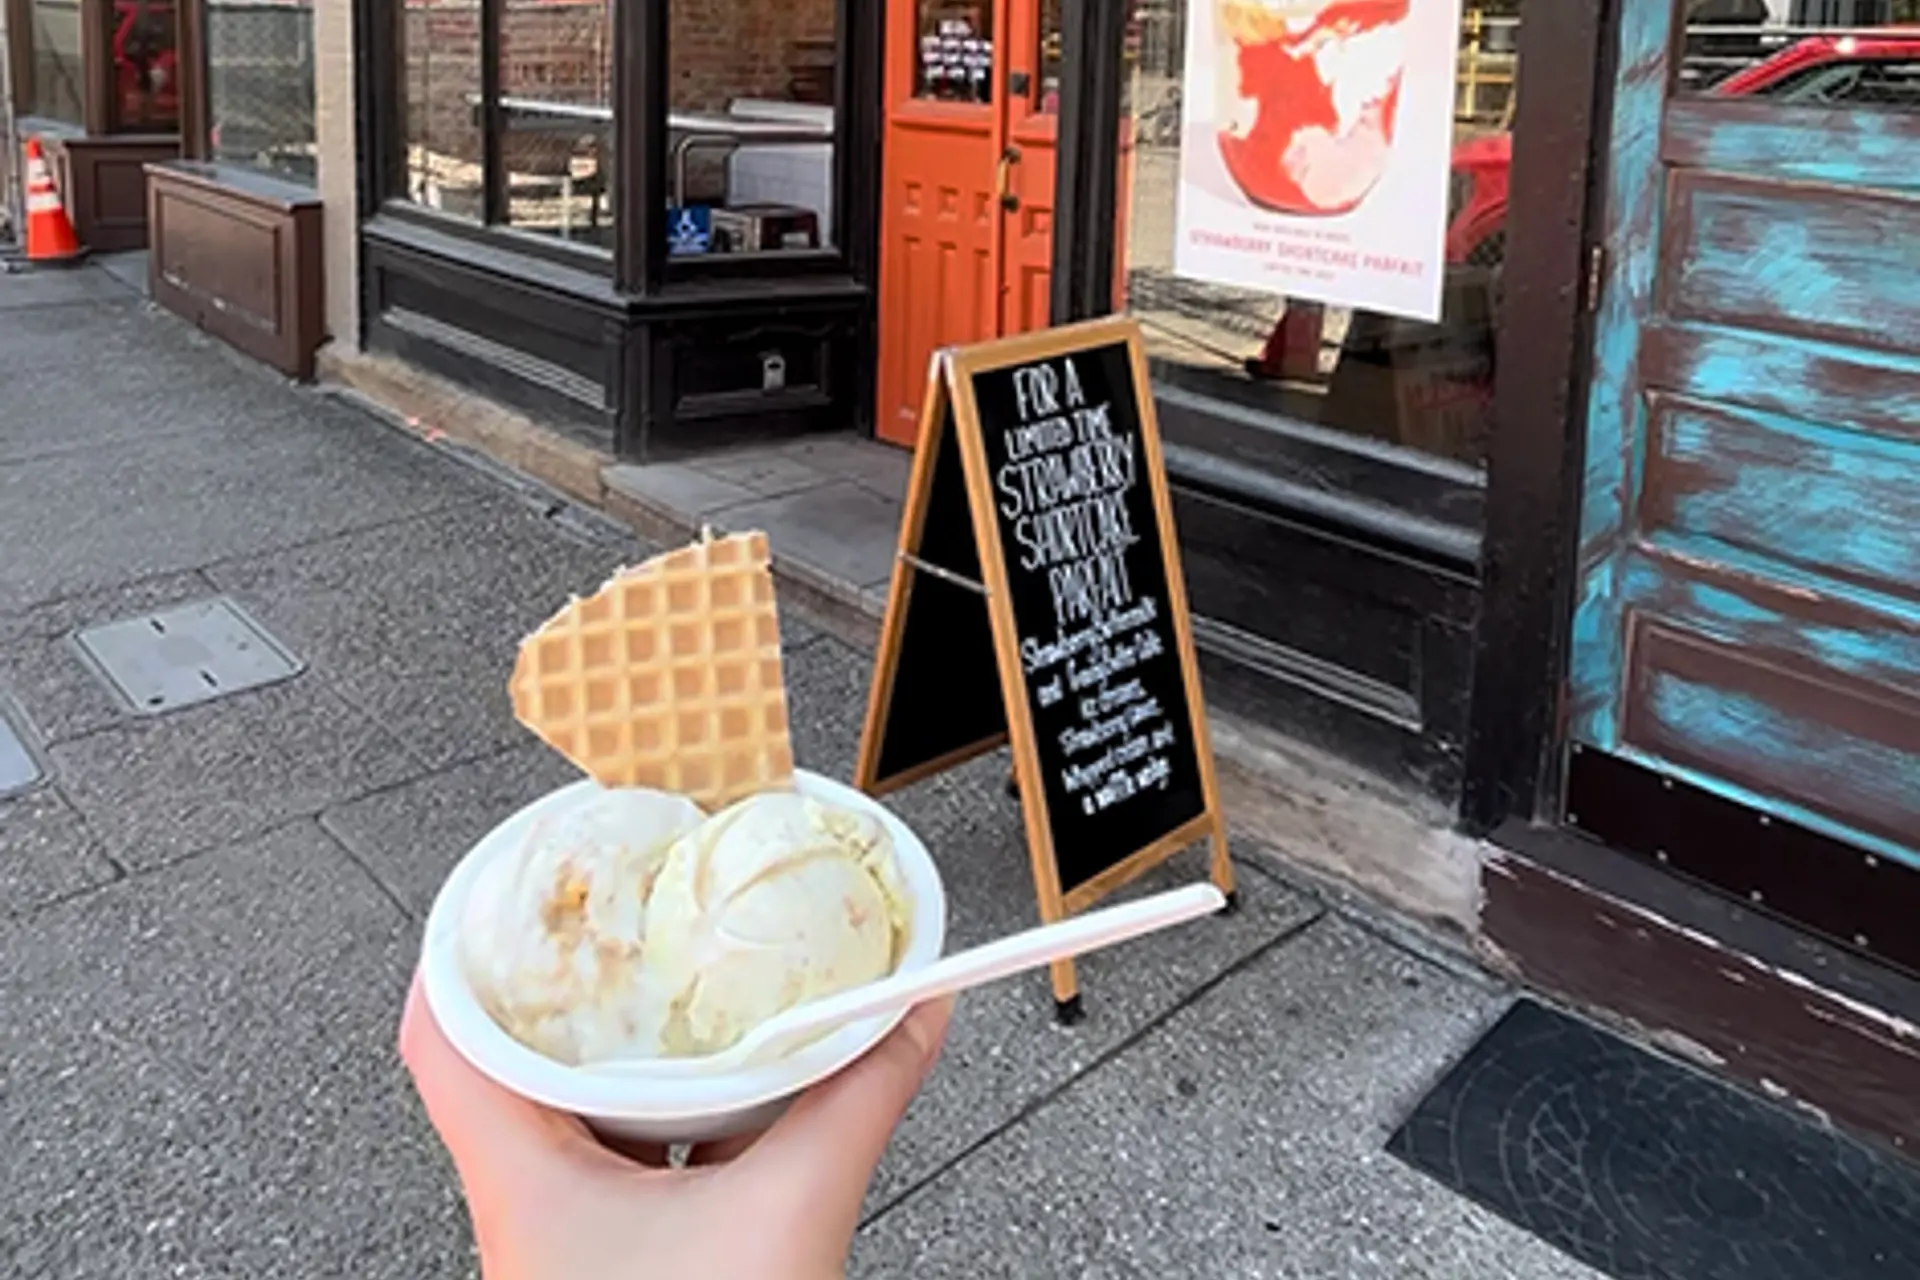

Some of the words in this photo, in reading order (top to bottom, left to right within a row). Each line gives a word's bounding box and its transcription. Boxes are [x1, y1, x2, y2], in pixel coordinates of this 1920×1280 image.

[1013, 363, 1060, 420] FOR
[1065, 357, 1084, 407] A
[997, 431, 1136, 520] STRAWBERRY
